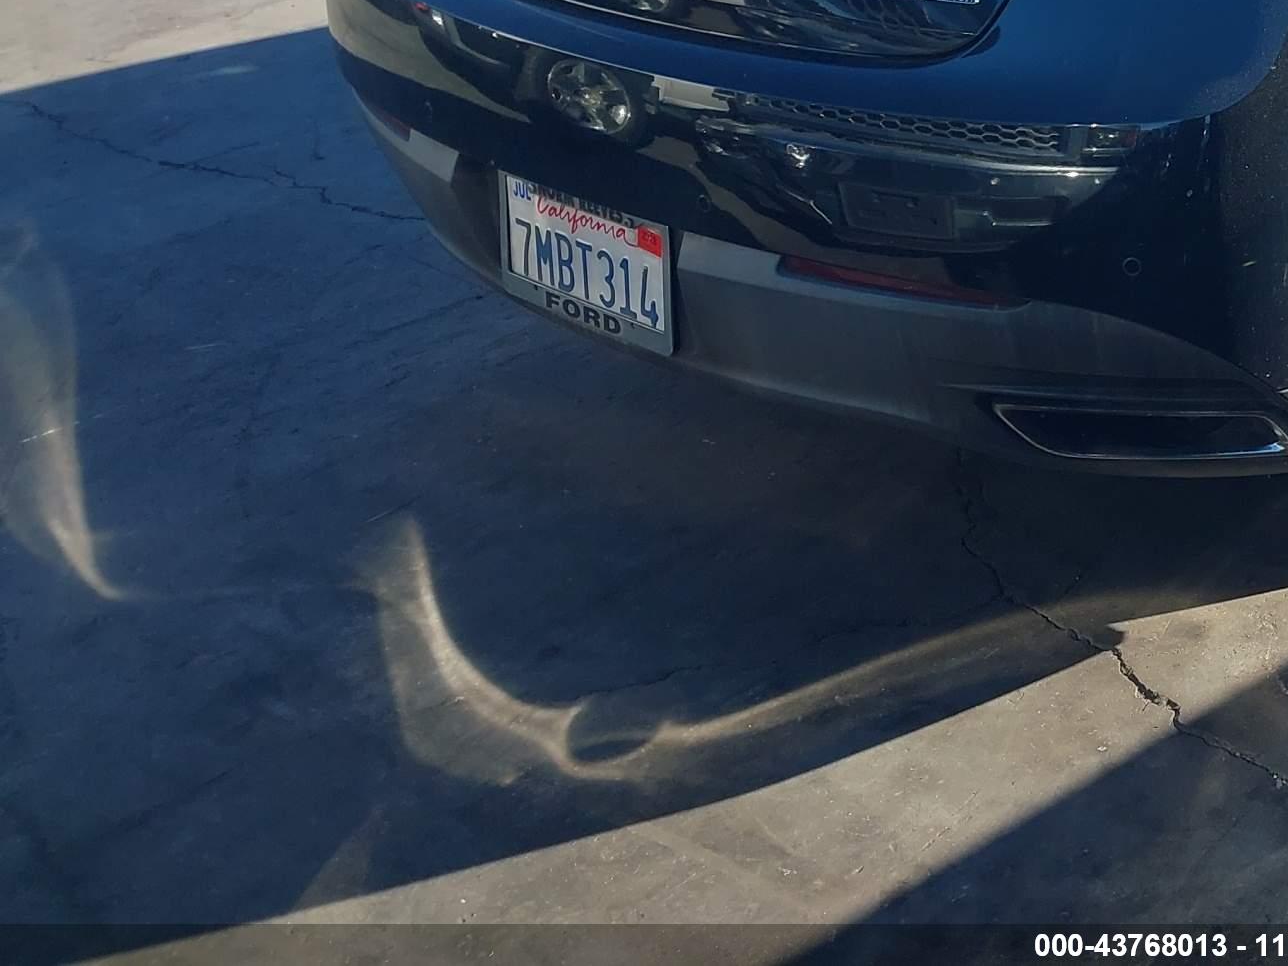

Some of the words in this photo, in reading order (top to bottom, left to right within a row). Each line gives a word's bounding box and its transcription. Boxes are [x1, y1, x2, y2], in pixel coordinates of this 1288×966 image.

[513, 181, 531, 201] JUL
[536, 196, 638, 246] California
[515, 217, 659, 328] 7MBT314
[545, 291, 621, 334] FORD
